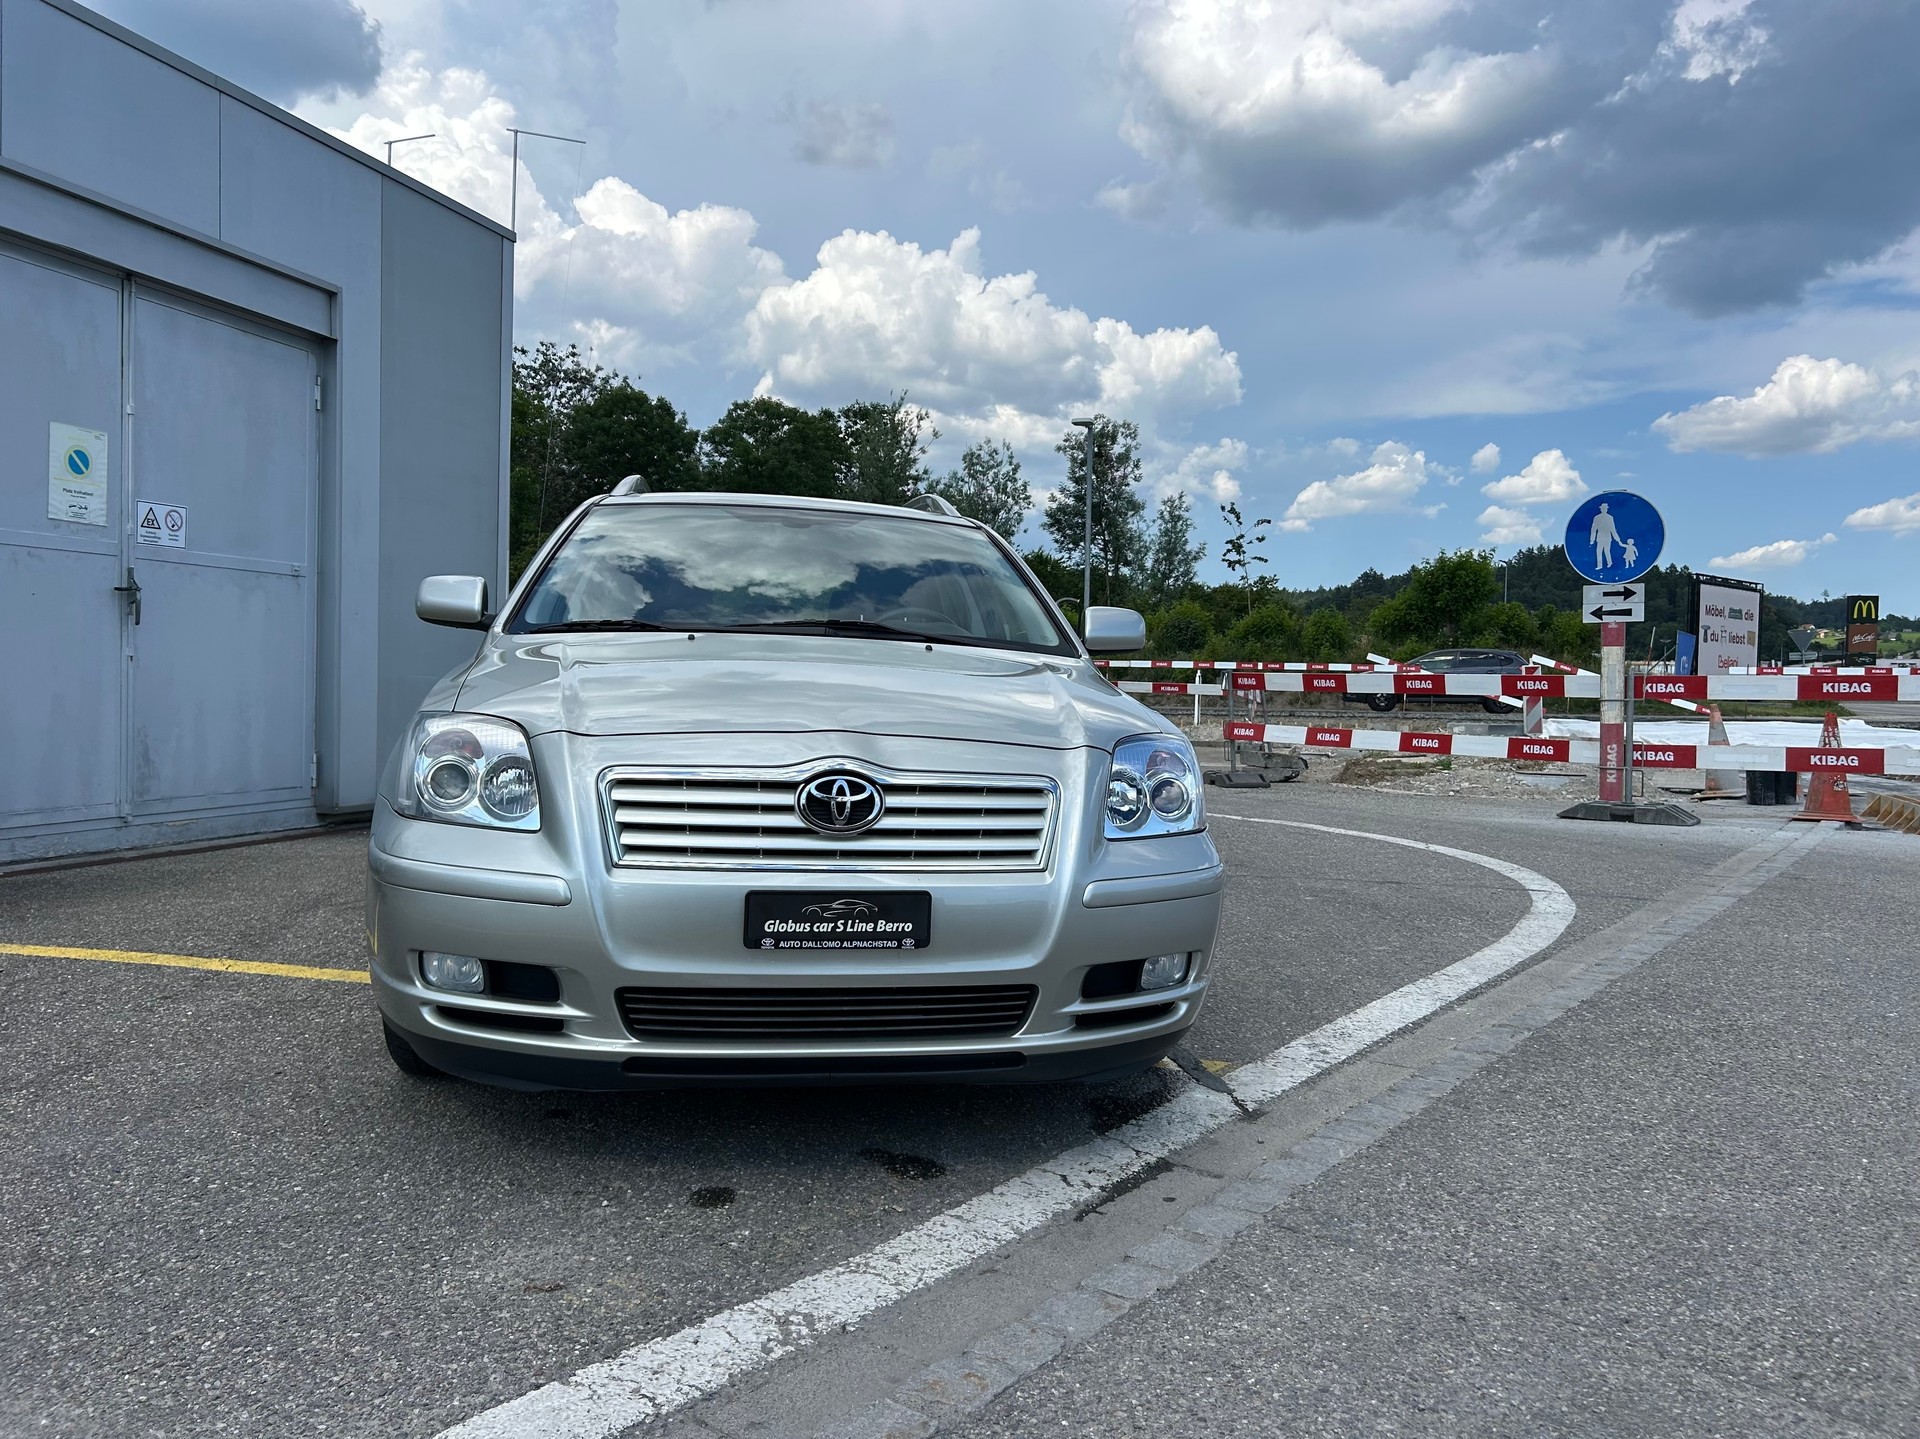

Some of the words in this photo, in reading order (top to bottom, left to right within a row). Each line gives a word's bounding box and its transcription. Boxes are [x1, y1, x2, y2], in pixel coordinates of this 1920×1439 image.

[146, 518, 156, 526] EX
[1704, 604, 1727, 620] Möbel,
[1744, 609, 1755, 622] die
[1709, 630, 1719, 643] du
[1728, 631, 1746, 645] liebst
[1237, 677, 1257, 685] KIBAG
[1313, 679, 1336, 688] KIBAG
[1406, 680, 1433, 689] KIBAG
[1516, 680, 1549, 690] KIBAG
[1644, 683, 1685, 693] KIBAG
[1822, 682, 1872, 693] KIBAG
[1233, 725, 1255, 737] KIBAG
[1316, 732, 1340, 742] KIBAG
[1411, 738, 1439, 748] KIBAG
[1522, 744, 1554, 755] KIBAG
[1632, 750, 1674, 761] KIBAG
[1809, 754, 1859, 767] KIBAG
[764, 919, 811, 932] Globus
[846, 919, 875, 932] Line
[876, 919, 913, 932] Berro
[778, 940, 801, 948] AUTO
[802, 940, 841, 948] DALL'OMO
[842, 940, 898, 948] ALPNACHSTAD
